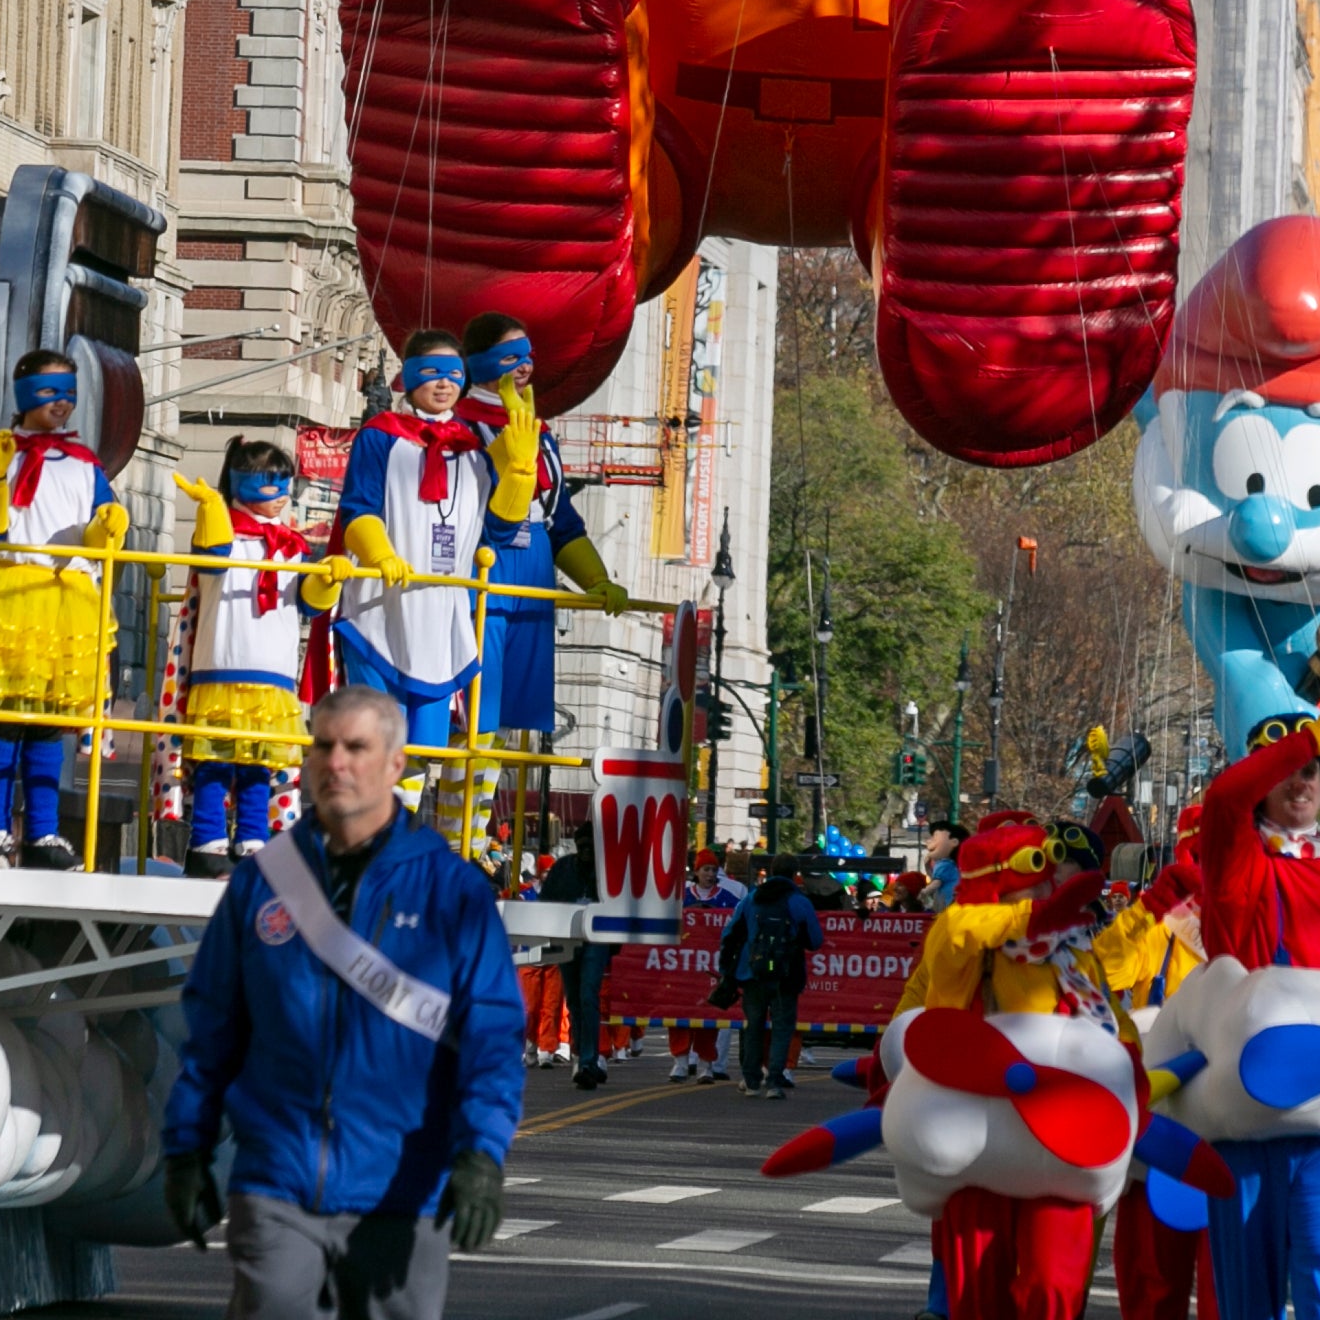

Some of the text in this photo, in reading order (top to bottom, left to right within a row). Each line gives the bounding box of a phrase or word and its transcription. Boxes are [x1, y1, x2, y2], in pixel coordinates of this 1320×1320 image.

[695, 434, 713, 560] HISTORY MUSEUM
[826, 917, 855, 932] DAY
[863, 918, 924, 934] PARADE
[347, 953, 413, 1010] FLOAT
[812, 953, 914, 979] SNOOPY
